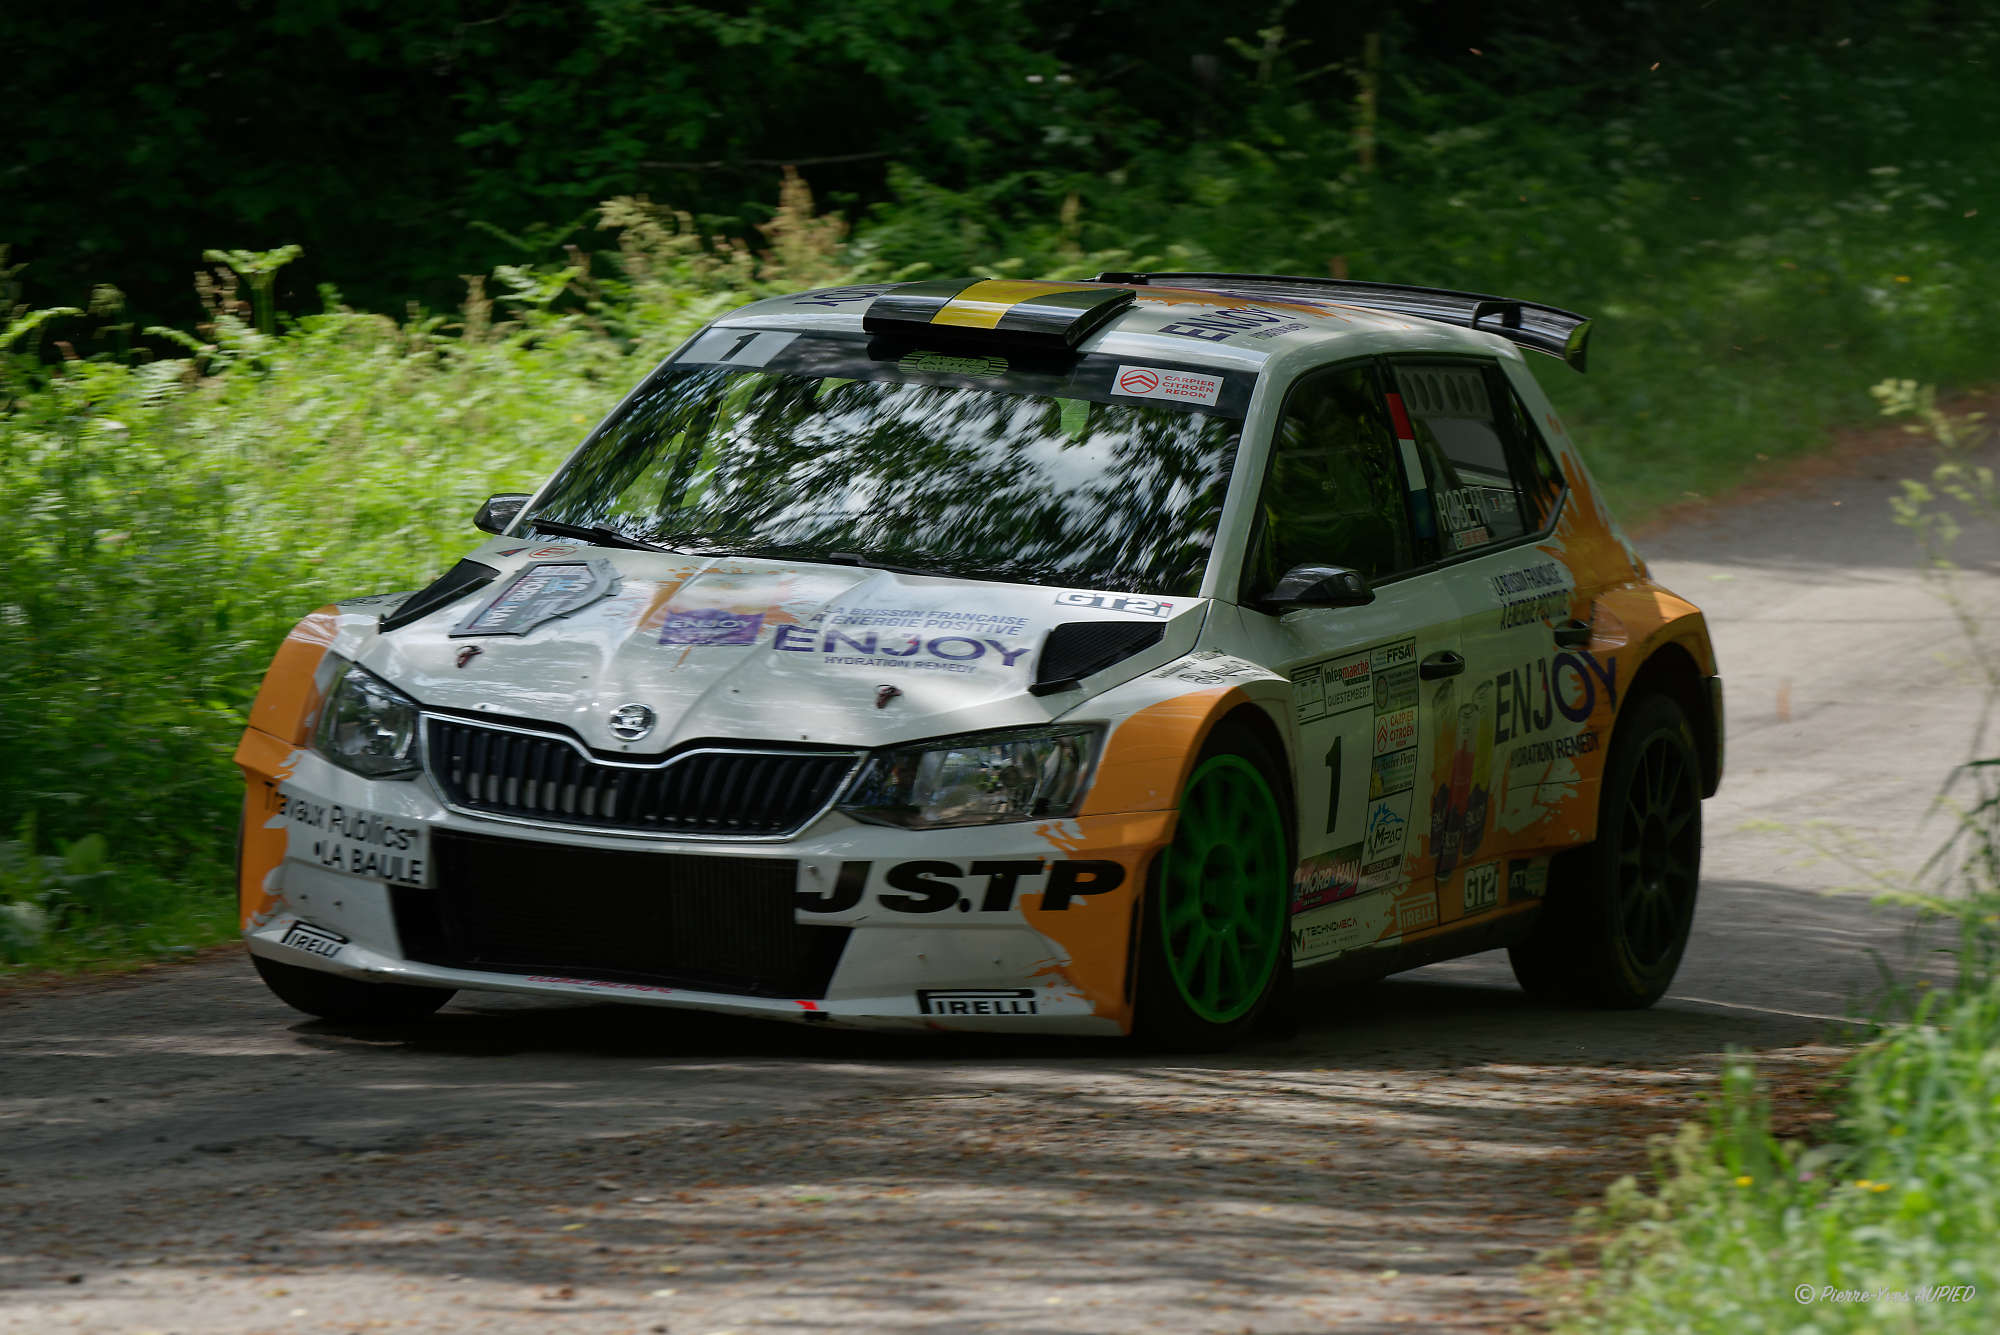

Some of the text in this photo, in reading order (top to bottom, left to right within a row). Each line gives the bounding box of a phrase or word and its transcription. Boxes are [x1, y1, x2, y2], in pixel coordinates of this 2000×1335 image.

[1157, 308, 1297, 342] ENJOY
[718, 331, 761, 362] 1
[1164, 375, 1215, 388] CARPIER
[1165, 389, 1207, 399] REDON
[825, 605, 847, 615] LA
[849, 607, 923, 619] BOISSON
[1055, 591, 1175, 618] GT2i
[923, 618, 1025, 636] POSITIVE
[772, 624, 1031, 667] ENJOY
[1386, 645, 1411, 664] FFSA
[824, 656, 978, 674] HYDRATION REMEDY
[1326, 685, 1371, 707] QUESTEMBERT
[1494, 651, 1617, 746] ENJOY
[1555, 732, 1600, 761] REMEDY
[1325, 735, 1341, 834] 1
[327, 803, 411, 851] Publics
[350, 848, 422, 885] BAULE
[281, 919, 351, 958] PIRELLI
[916, 988, 1037, 1016] PIRELLI
